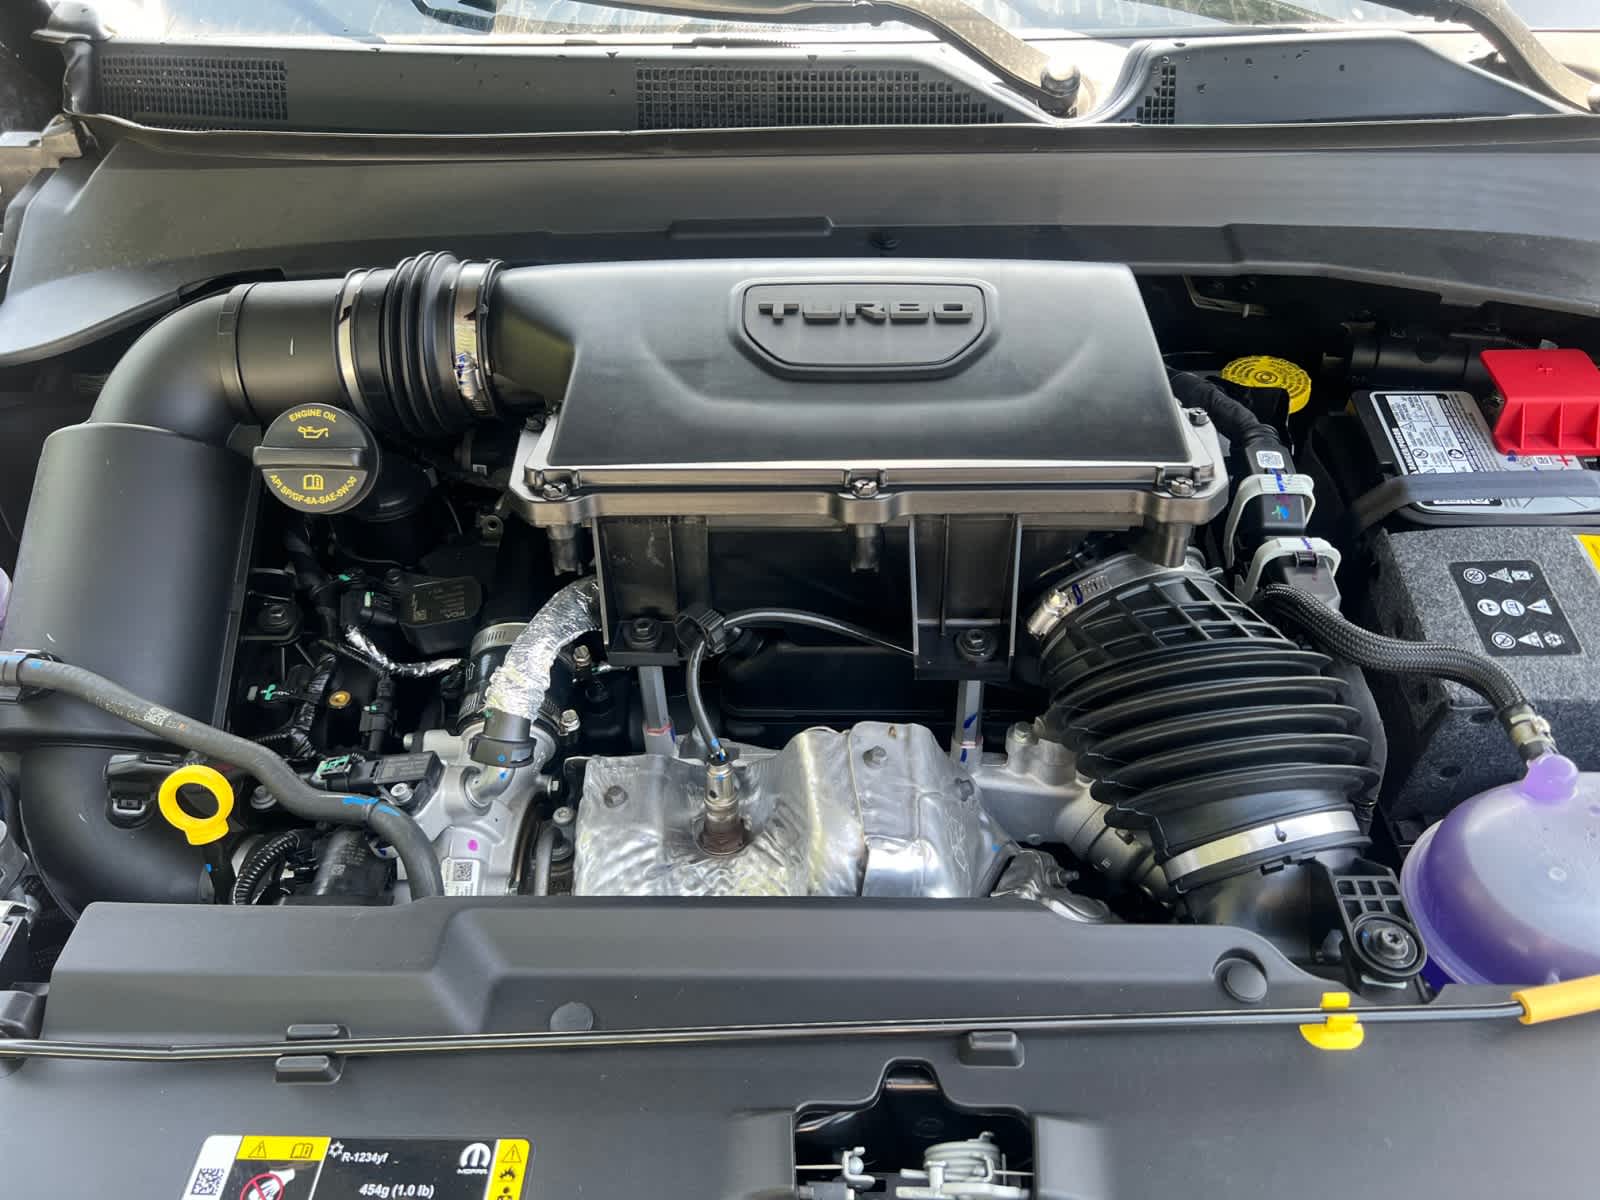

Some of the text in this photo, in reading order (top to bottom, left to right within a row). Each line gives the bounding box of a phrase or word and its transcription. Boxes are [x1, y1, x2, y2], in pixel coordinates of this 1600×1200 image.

[758, 303, 973, 322] TURBO
[288, 408, 337, 423] ENGINE OIL
[270, 474, 283, 489] API
[341, 1152, 389, 1165] R-1234yf
[358, 1184, 434, 1200] 454g (1.0 lb)
